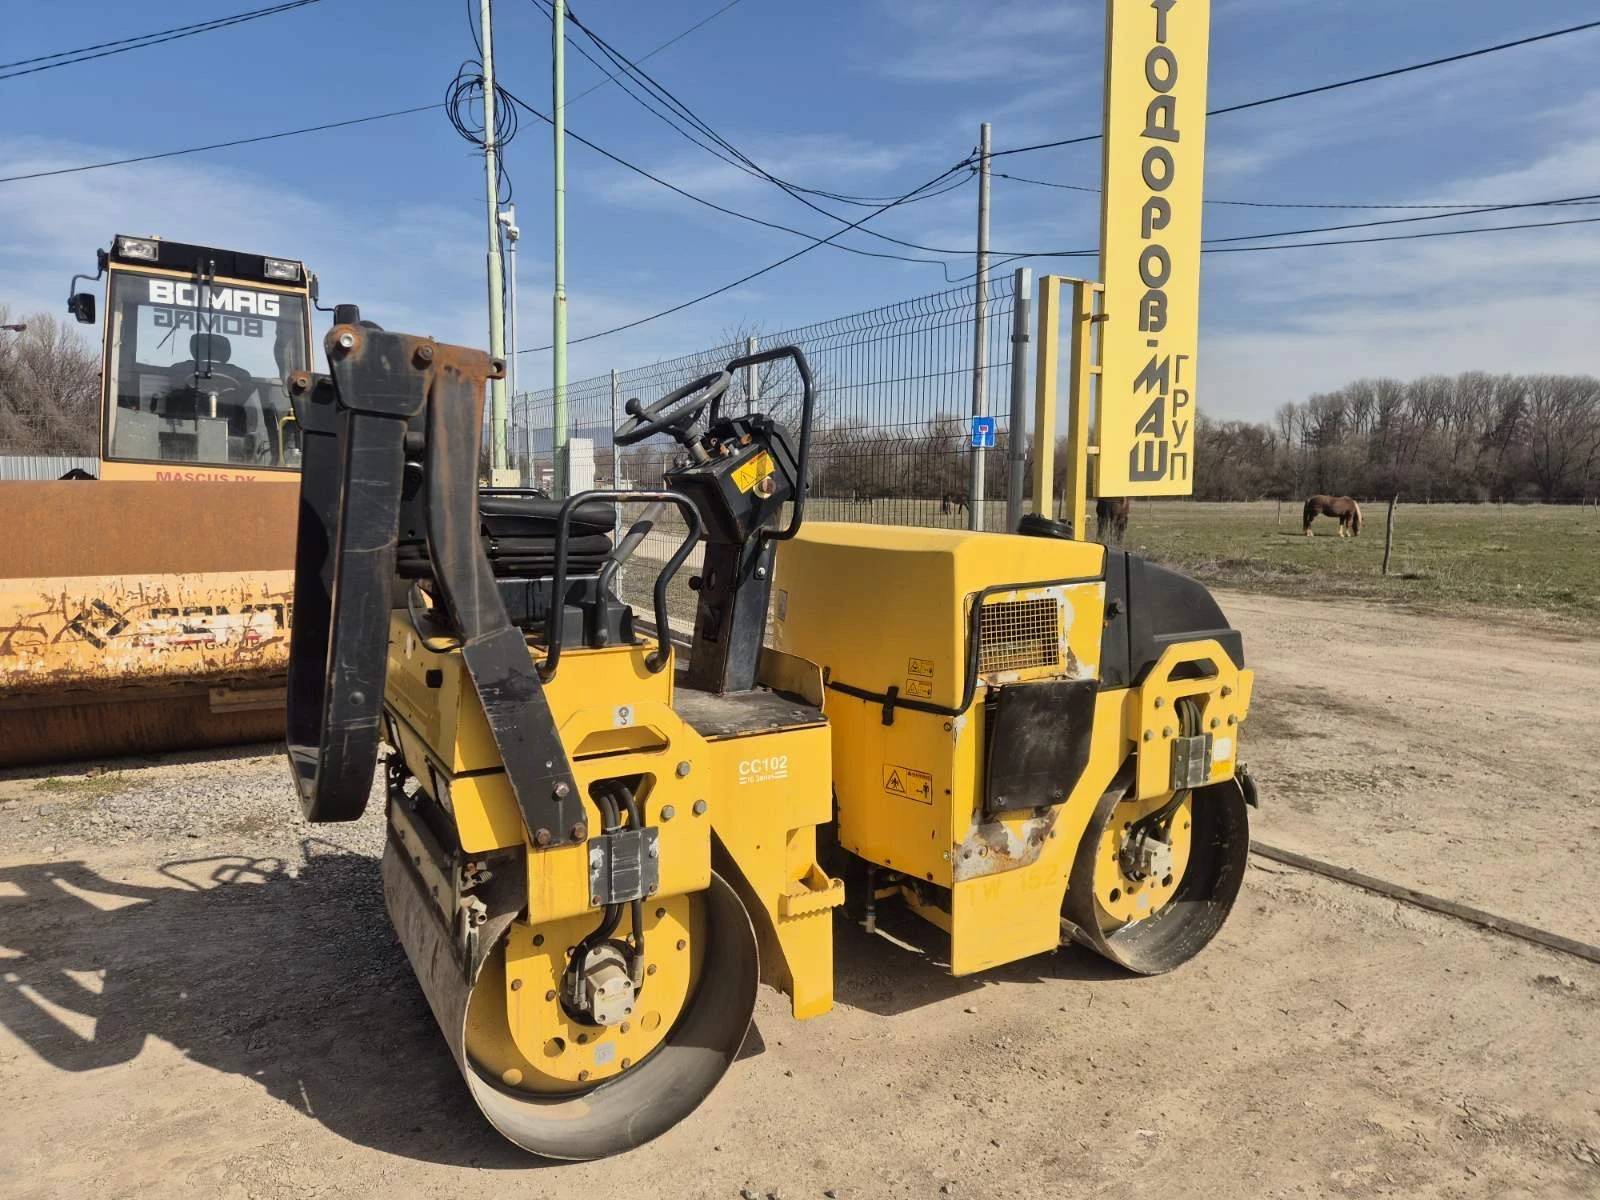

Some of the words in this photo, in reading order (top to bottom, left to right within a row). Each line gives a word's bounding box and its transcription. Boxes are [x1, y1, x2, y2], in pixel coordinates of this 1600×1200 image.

[149, 279, 280, 317] BOMAG
[1170, 354, 1190, 481] ГРУП
[738, 755, 788, 775] CC102
